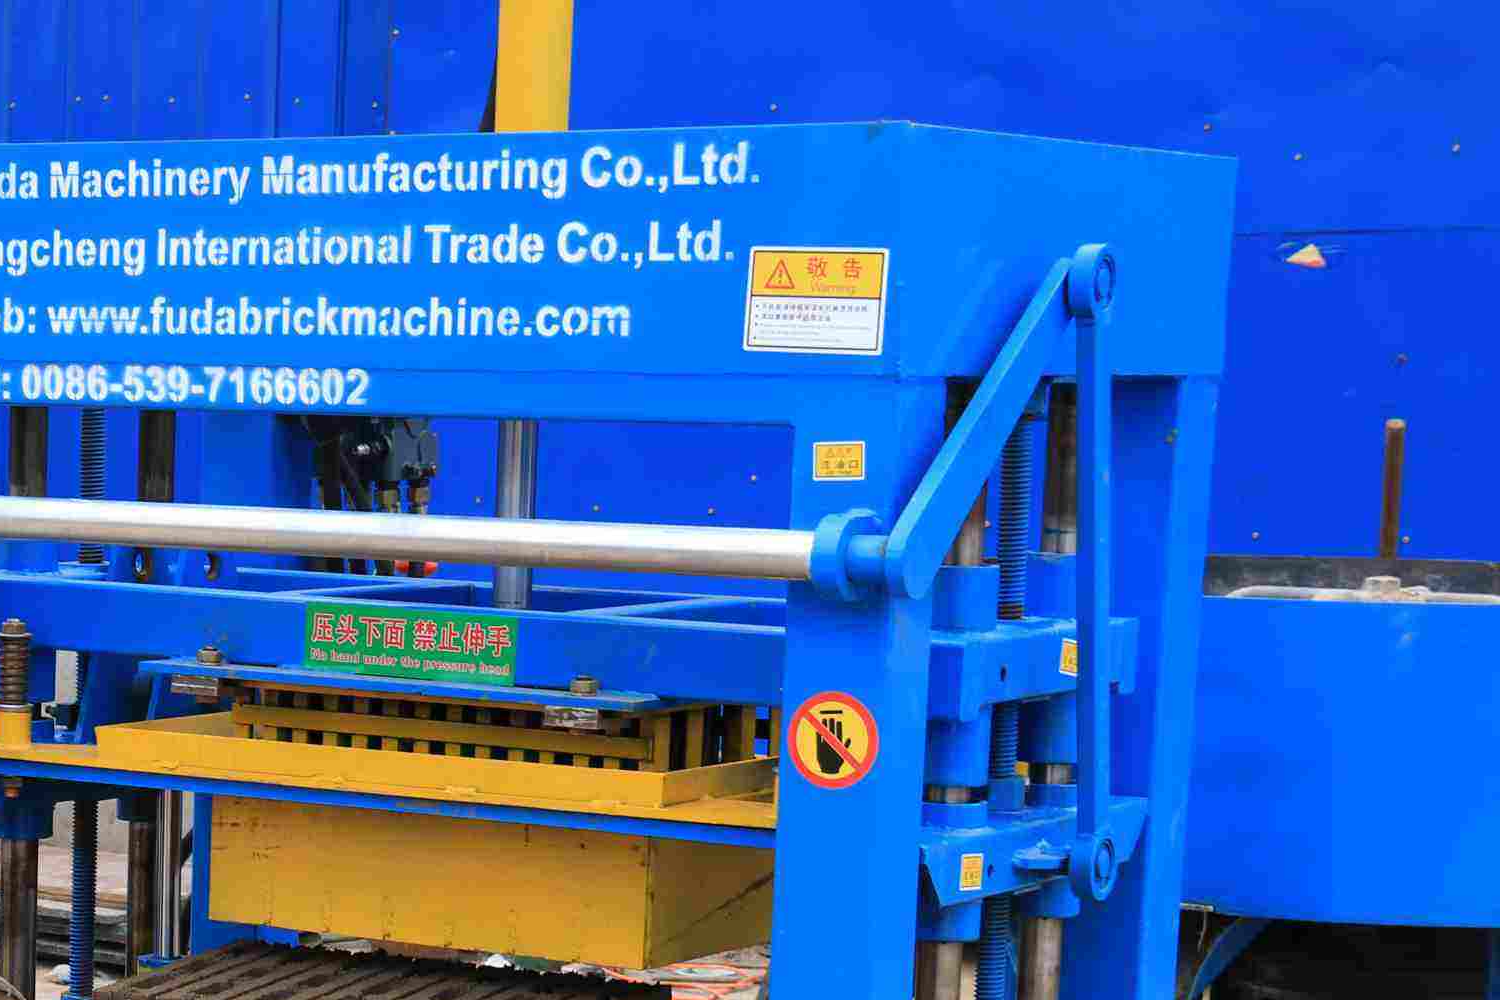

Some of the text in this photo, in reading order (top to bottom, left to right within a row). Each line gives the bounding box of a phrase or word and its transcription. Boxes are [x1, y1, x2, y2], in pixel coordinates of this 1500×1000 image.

[49, 158, 251, 206] Machinery
[262, 149, 569, 199] Manufacturing
[581, 141, 760, 194] Co.,Ltd.
[157, 223, 413, 267] International
[423, 222, 545, 265] Trade
[557, 218, 735, 270] Co.,Ltd.
[47, 296, 632, 338] www.fudabrickmachine.com
[21, 363, 371, 406] 0086-539-7166602
[310, 612, 512, 657] 压头下面 禁止伸手
[330, 649, 360, 664] hand
[363, 653, 398, 667] under
[401, 655, 421, 669] the
